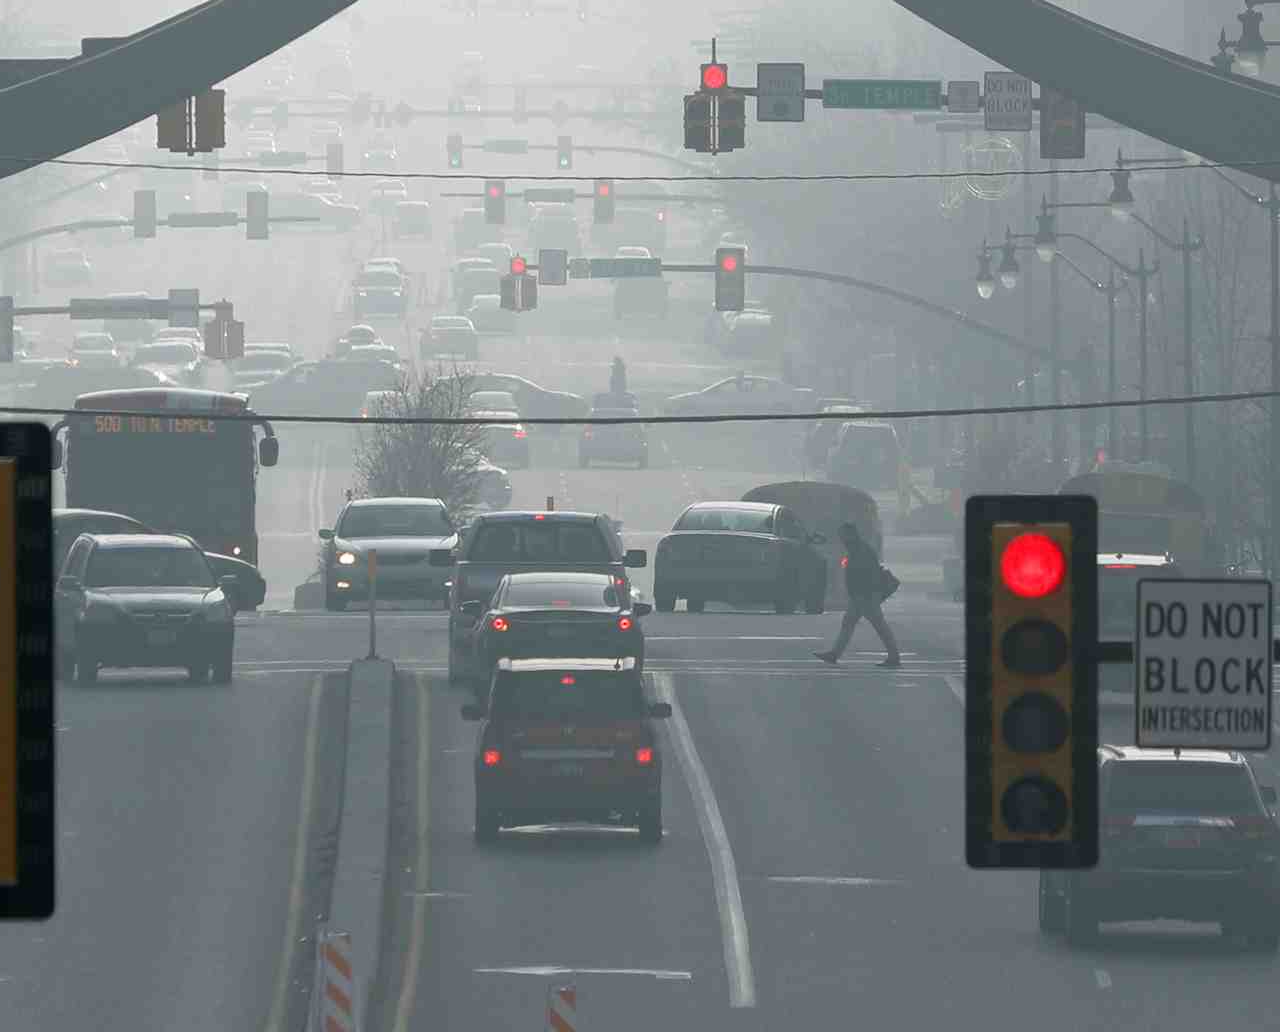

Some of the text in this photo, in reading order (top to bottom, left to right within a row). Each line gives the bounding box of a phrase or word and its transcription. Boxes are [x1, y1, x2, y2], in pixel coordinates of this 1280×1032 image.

[863, 86, 939, 105] TEMPLE
[1144, 601, 1264, 639] DO NOT
[1144, 656, 1265, 695] BLOCK
[1141, 704, 1265, 734] INTERSECTION
